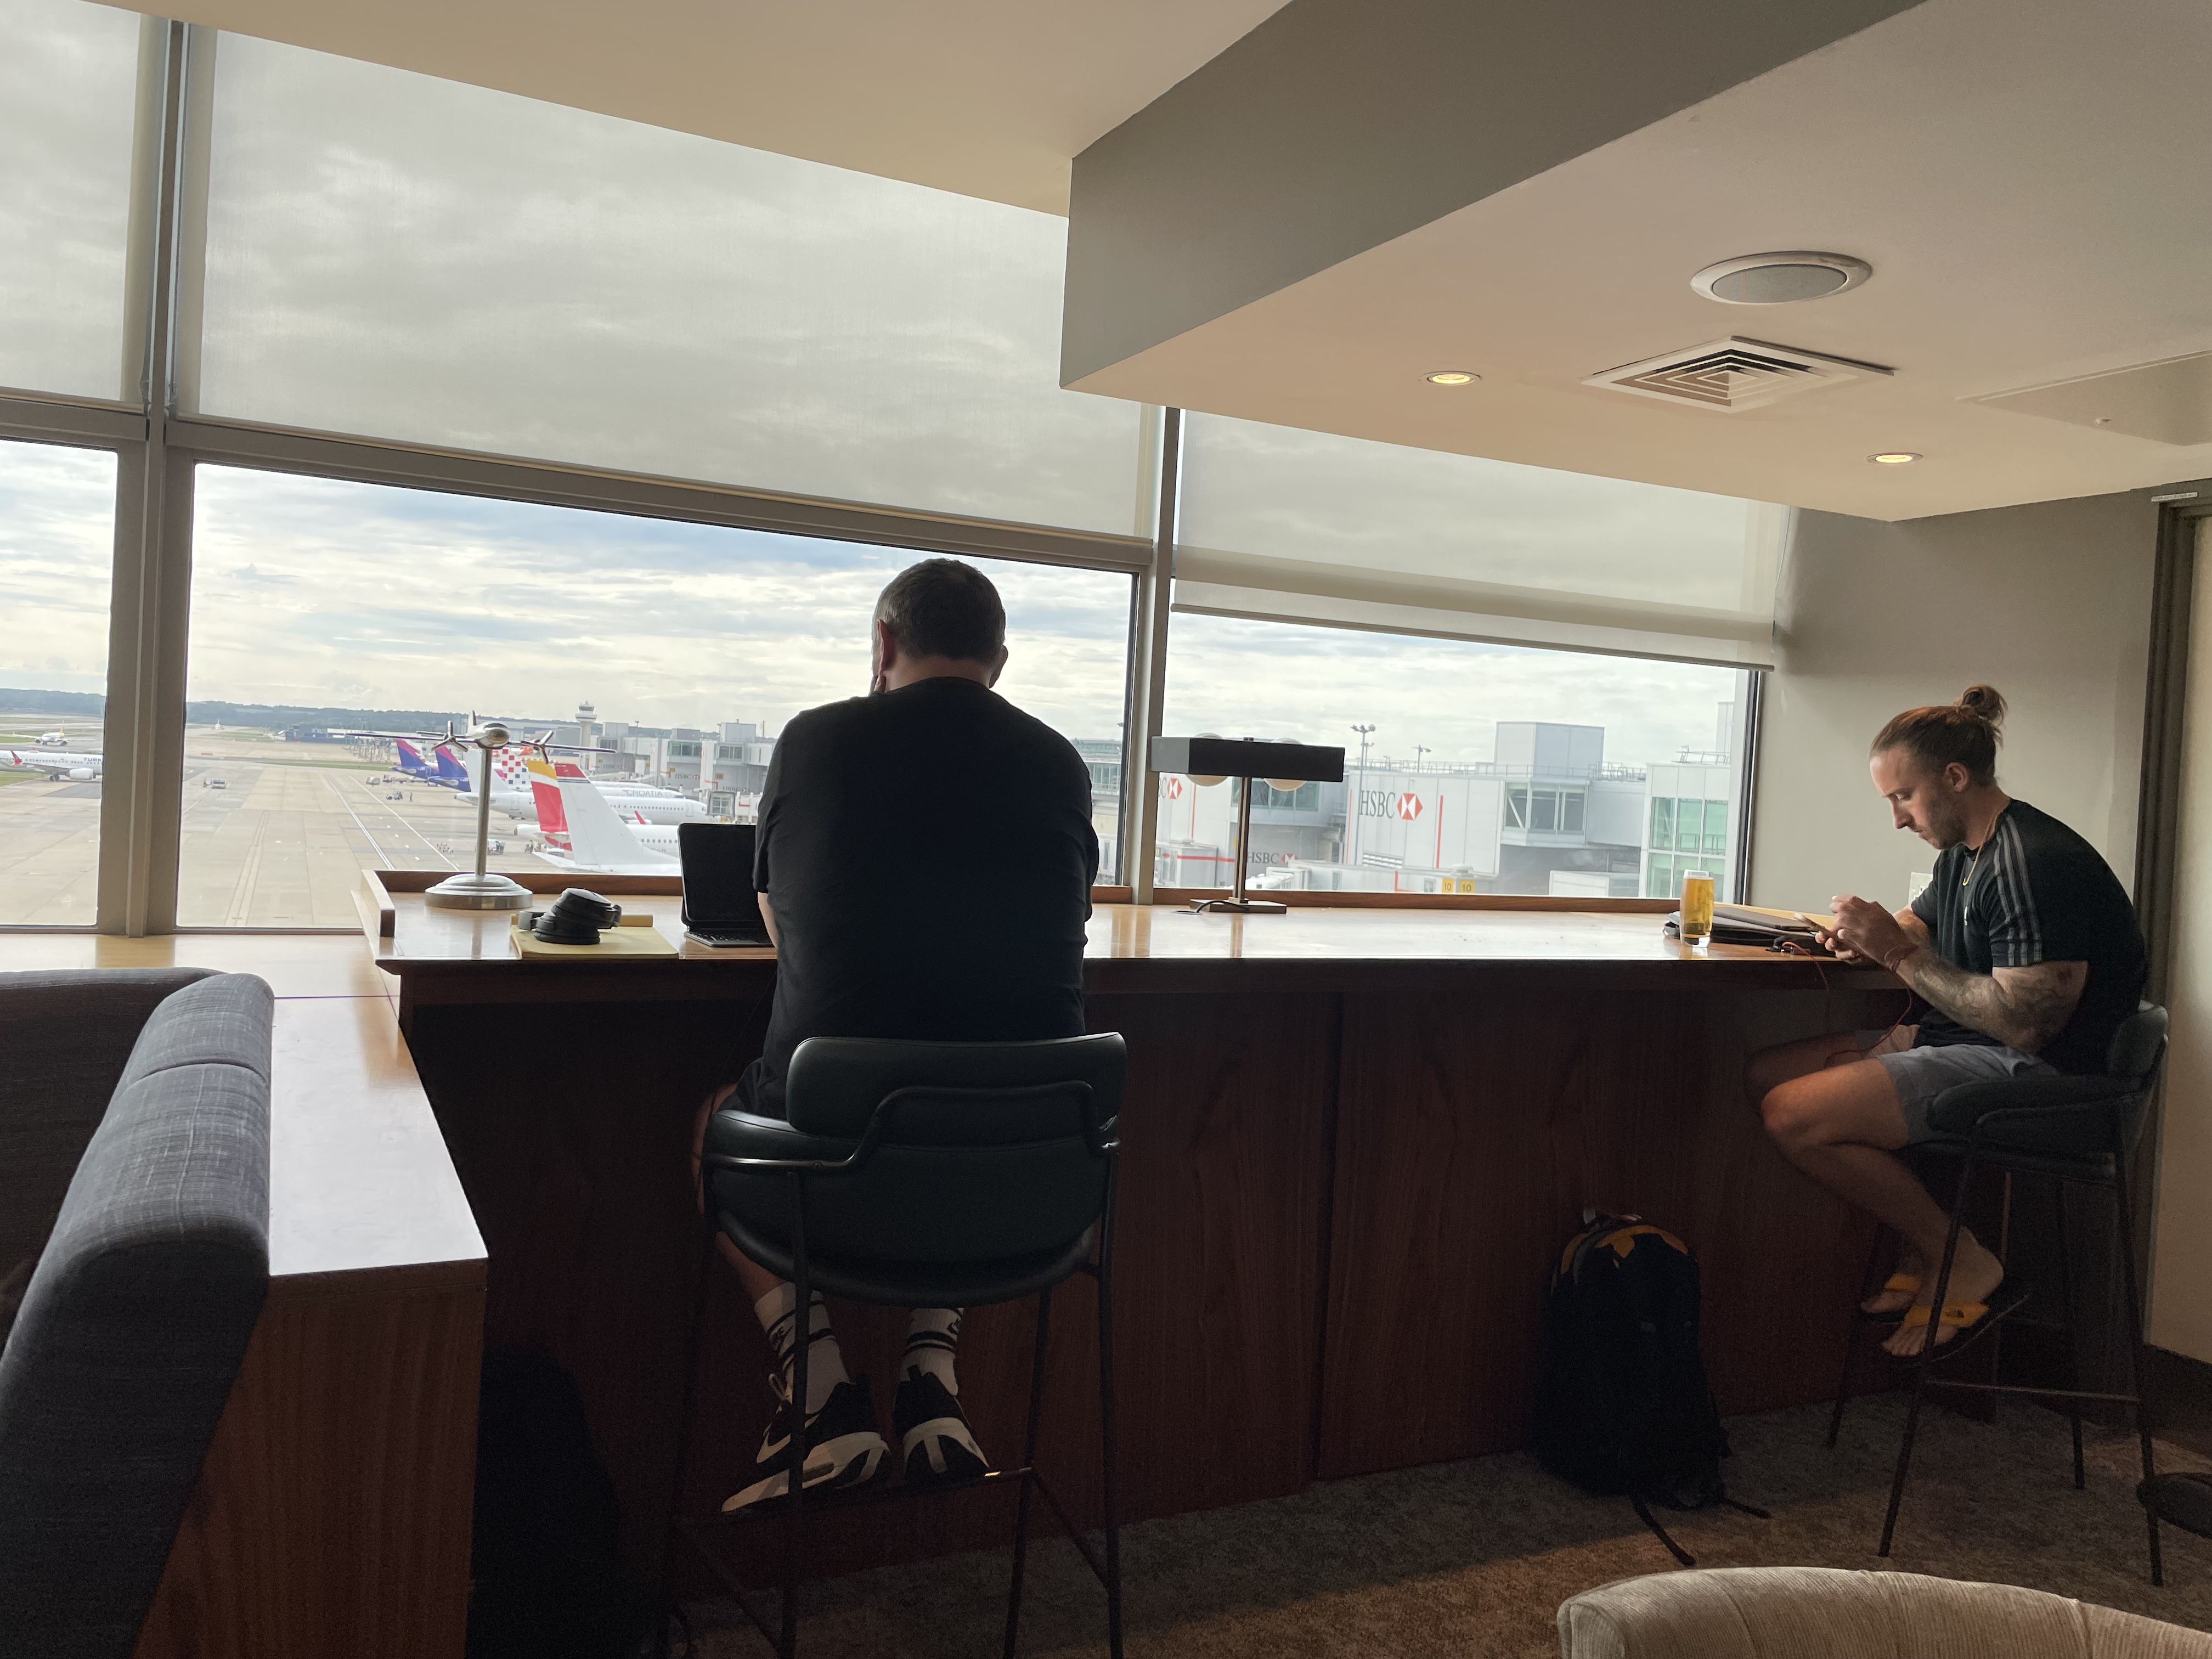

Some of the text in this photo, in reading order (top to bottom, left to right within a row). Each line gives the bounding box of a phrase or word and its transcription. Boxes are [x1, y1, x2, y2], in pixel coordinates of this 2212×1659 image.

[627, 789, 663, 798] CROATIA
[1359, 790, 1396, 819] HSBC
[1247, 851, 1279, 864] HSBC
[1444, 882, 1452, 891] 10
[1463, 884, 1471, 893] 10
